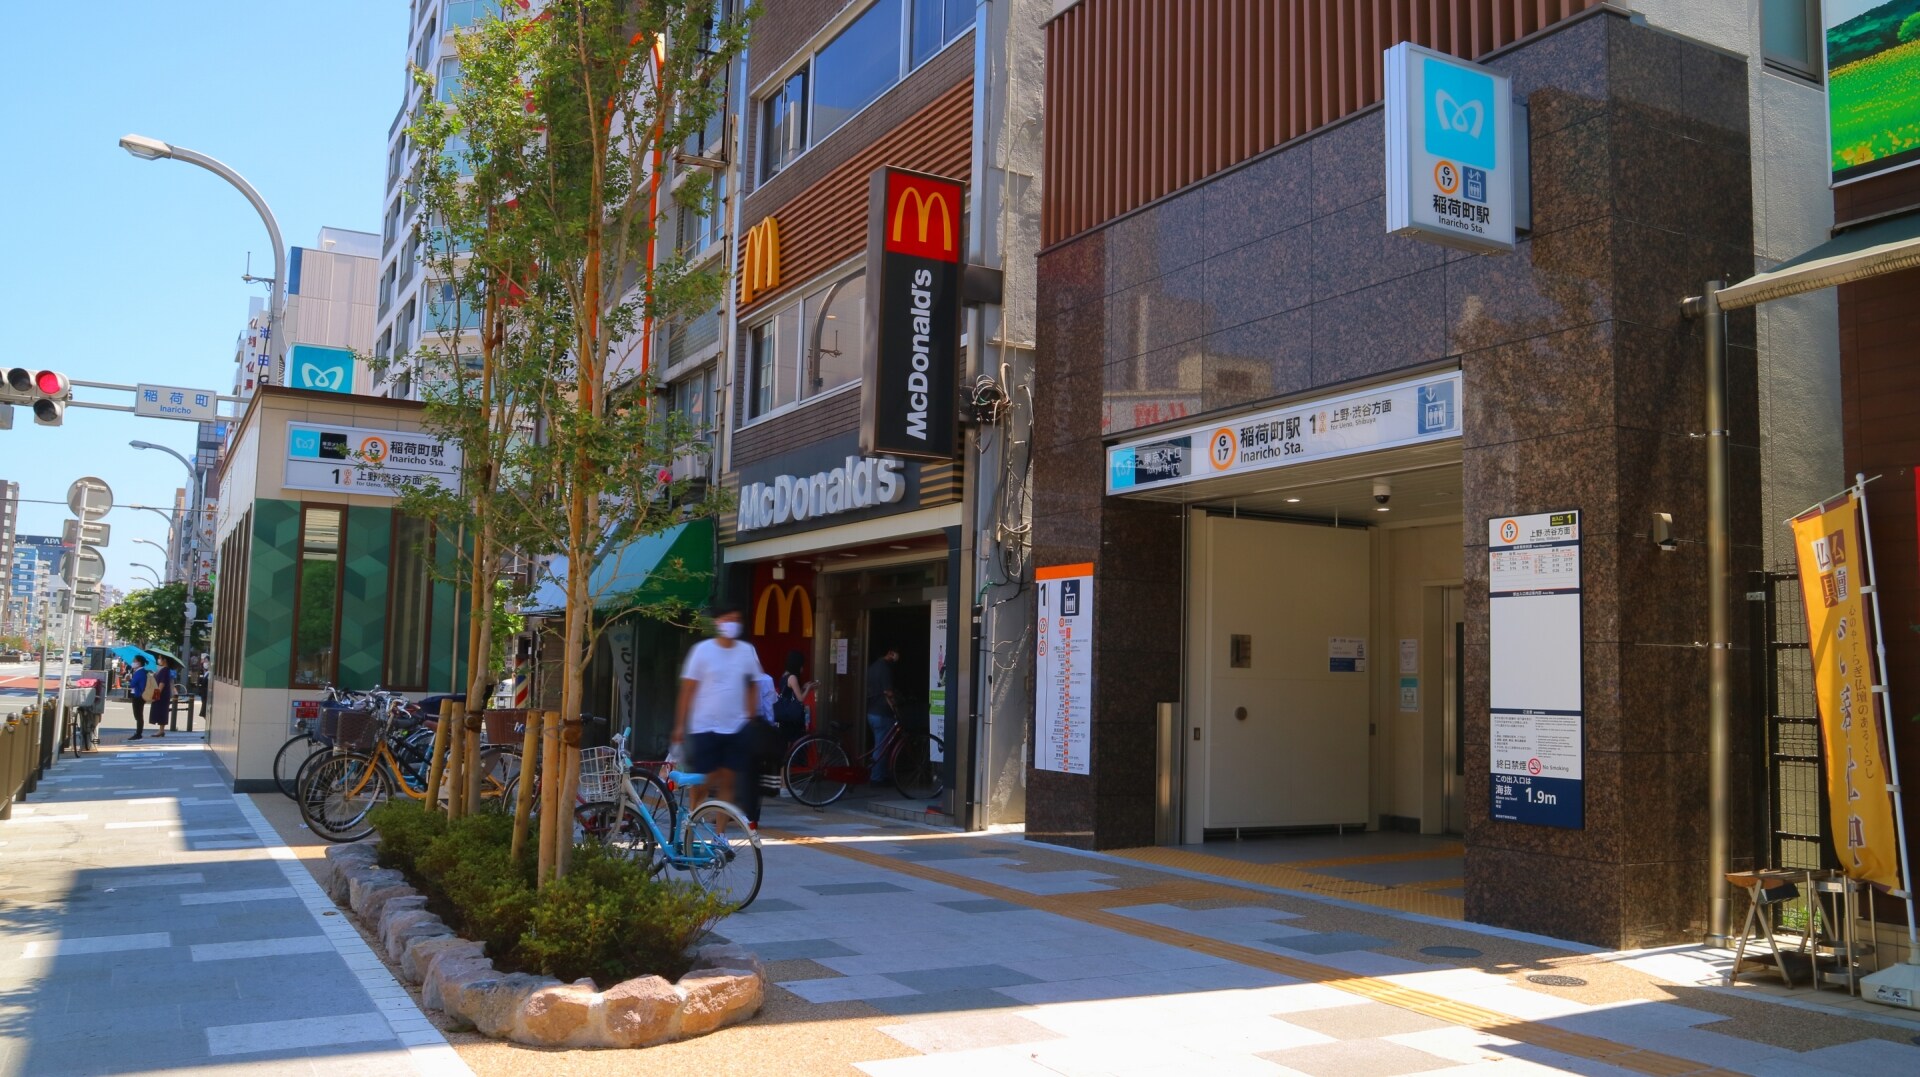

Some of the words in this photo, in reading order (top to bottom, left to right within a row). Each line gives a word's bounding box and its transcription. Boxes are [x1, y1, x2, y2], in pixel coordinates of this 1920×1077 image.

[1443, 166, 1450, 176] G
[1442, 176, 1453, 187] 17
[1433, 194, 1490, 225] 稲荷町駅
[1439, 215, 1468, 230] Inaricho
[1471, 223, 1485, 234] Sta.
[906, 268, 932, 441] McDonald's
[143, 389, 209, 408] 稲荷町
[160, 404, 192, 415] Inaricho
[1309, 414, 1316, 435] 1
[1240, 416, 1301, 449] 稲荷町駅
[371, 441, 378, 449] G
[1219, 435, 1227, 447] G
[389, 440, 445, 459] 稲荷町駅
[1143, 446, 1182, 465] 東京メトロ
[1217, 448, 1229, 461] 17
[1240, 445, 1281, 464] Inaricho
[1284, 441, 1304, 456] Sta.
[389, 454, 427, 466] Inaricho
[429, 457, 447, 467] Sta.
[332, 468, 341, 485] 1
[737, 455, 905, 532] McDonald's
[1566, 514, 1572, 524] 1
[1506, 523, 1512, 531] G
[43, 537, 61, 545] APA
[1040, 583, 1047, 607] 1
[1496, 759, 1527, 771] 終日禁煙
[1550, 764, 1569, 773] Smoking
[1495, 775, 1532, 785] この出入口は
[1495, 784, 1513, 796] 海抜
[1525, 787, 1557, 805] 1.9m
